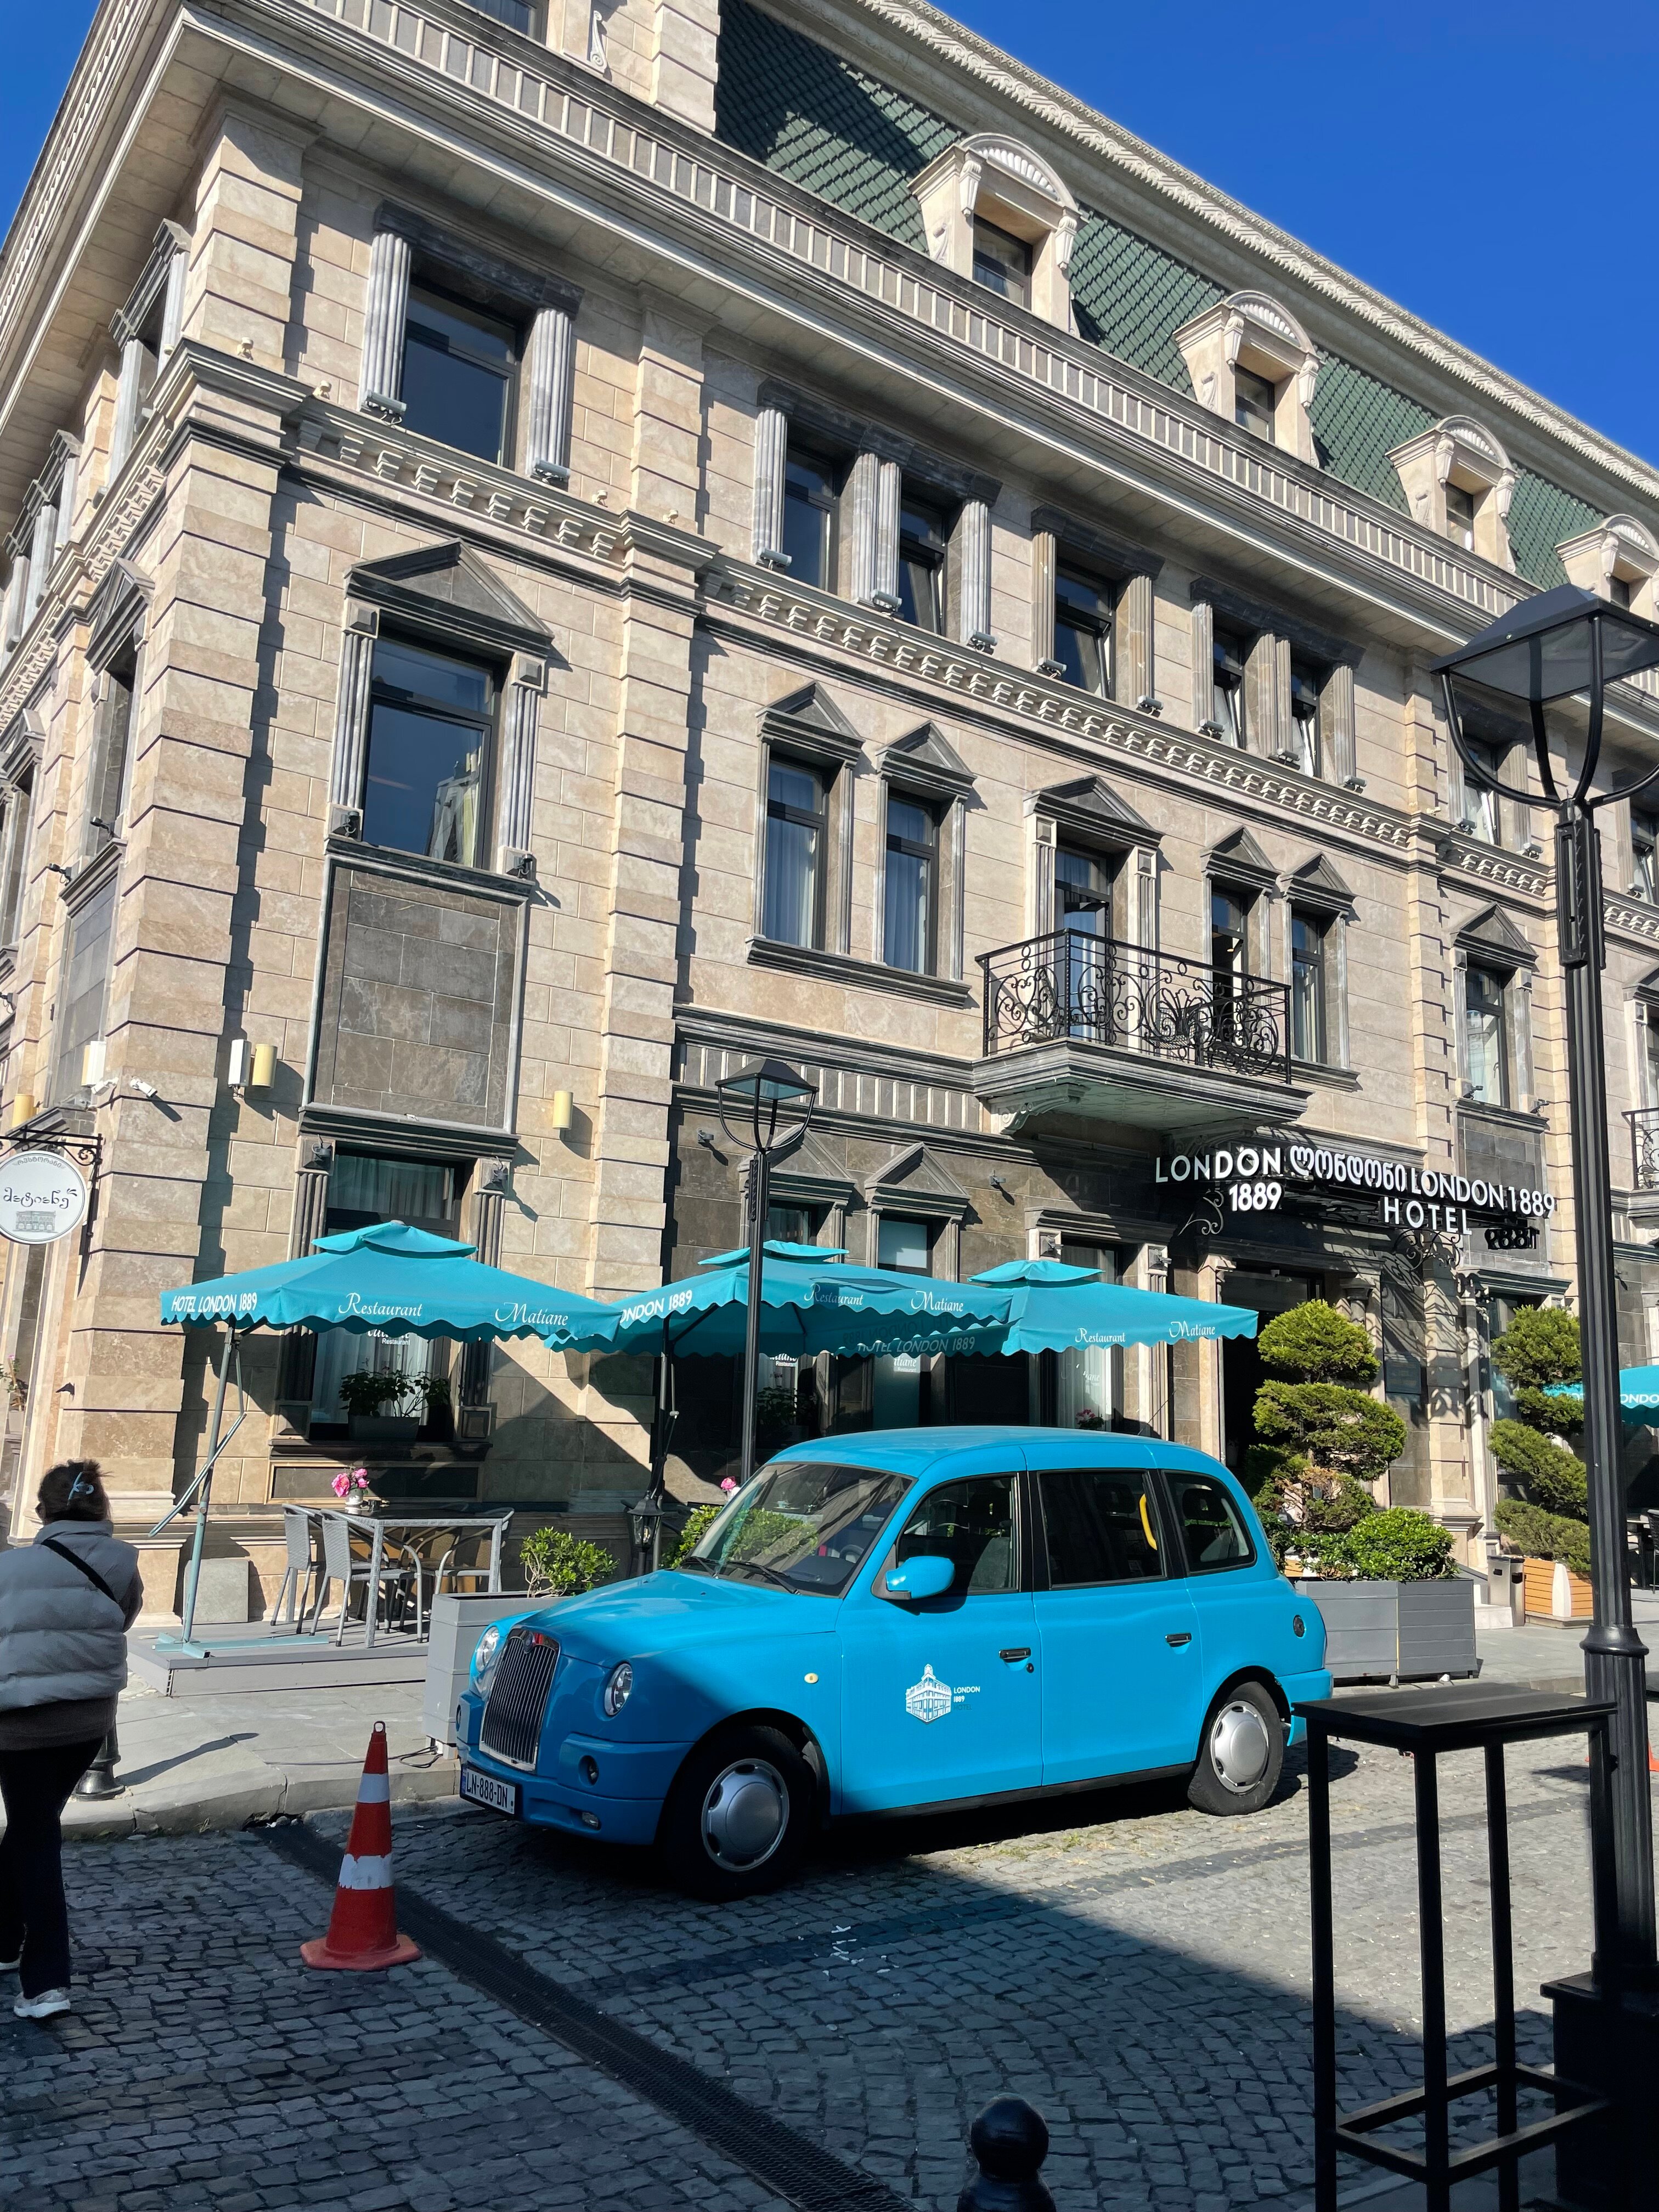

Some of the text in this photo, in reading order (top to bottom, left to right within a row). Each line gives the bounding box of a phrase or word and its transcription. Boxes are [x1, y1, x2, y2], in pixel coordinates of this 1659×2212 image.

[1155, 1148, 1281, 1183] LONDON
[1229, 1182, 1282, 1211] 1889
[1290, 1145, 1555, 1218] ლონდონი LONDON 1889
[1384, 1197, 1472, 1235] HOTEL
[171, 1292, 257, 1312] HOTEL LONDON 1889
[338, 1292, 568, 1326] Restaurant Matiane
[620, 1289, 692, 1323] ONDON 1889
[804, 1283, 963, 1312] Restaurant Matiane
[896, 1339, 949, 1352] LONDON
[952, 1336, 975, 1351] 1889
[1075, 1320, 1215, 1343] Restaurant Matiane
[1620, 1393, 1659, 1404] ONDO
[466, 1771, 508, 1808] LN-888-DN
